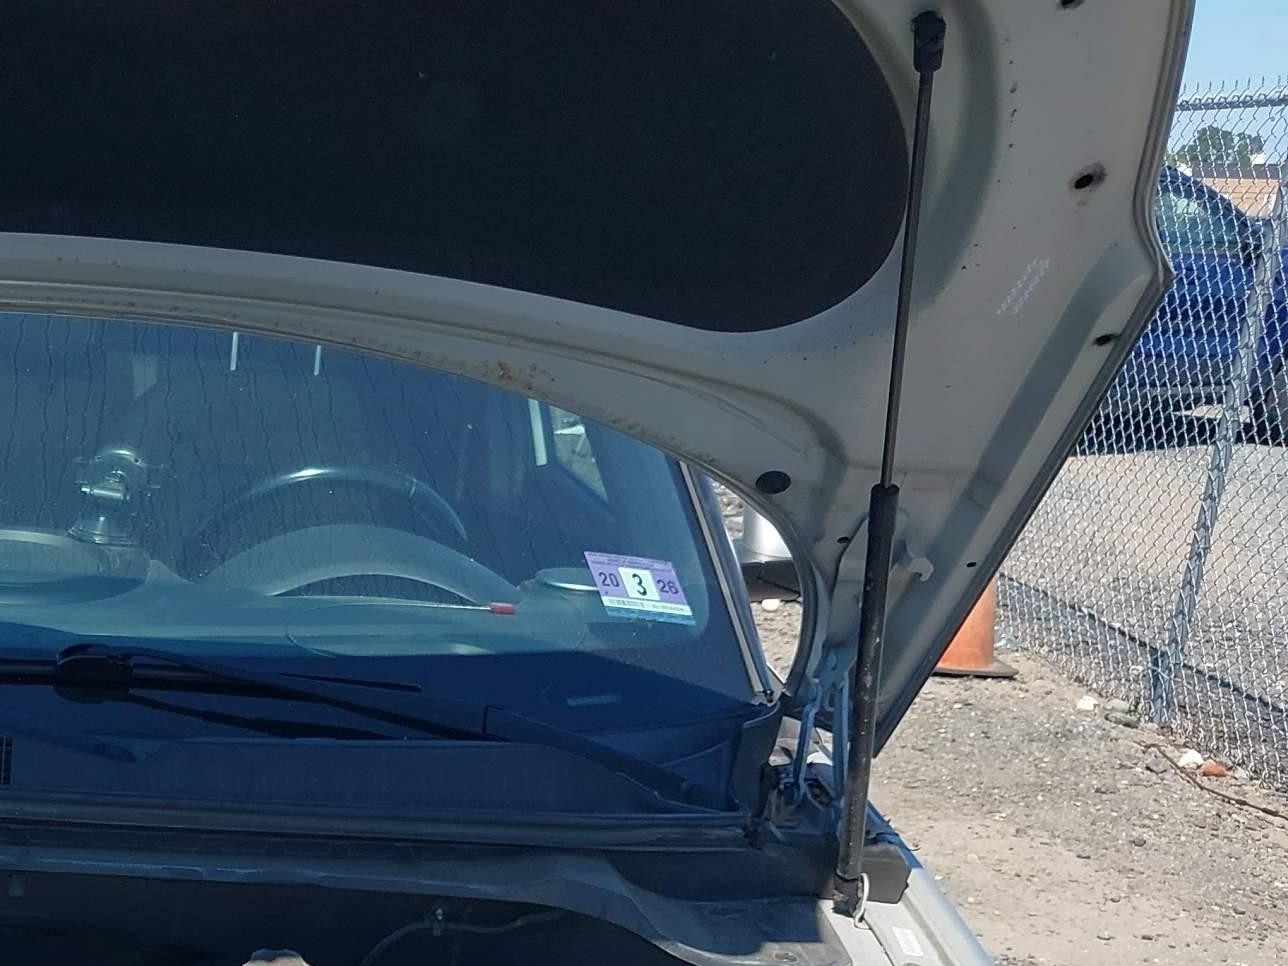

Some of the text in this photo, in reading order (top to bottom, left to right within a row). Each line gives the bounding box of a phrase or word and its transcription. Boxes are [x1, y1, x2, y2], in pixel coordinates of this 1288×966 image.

[598, 572, 679, 596] 20 3 26
